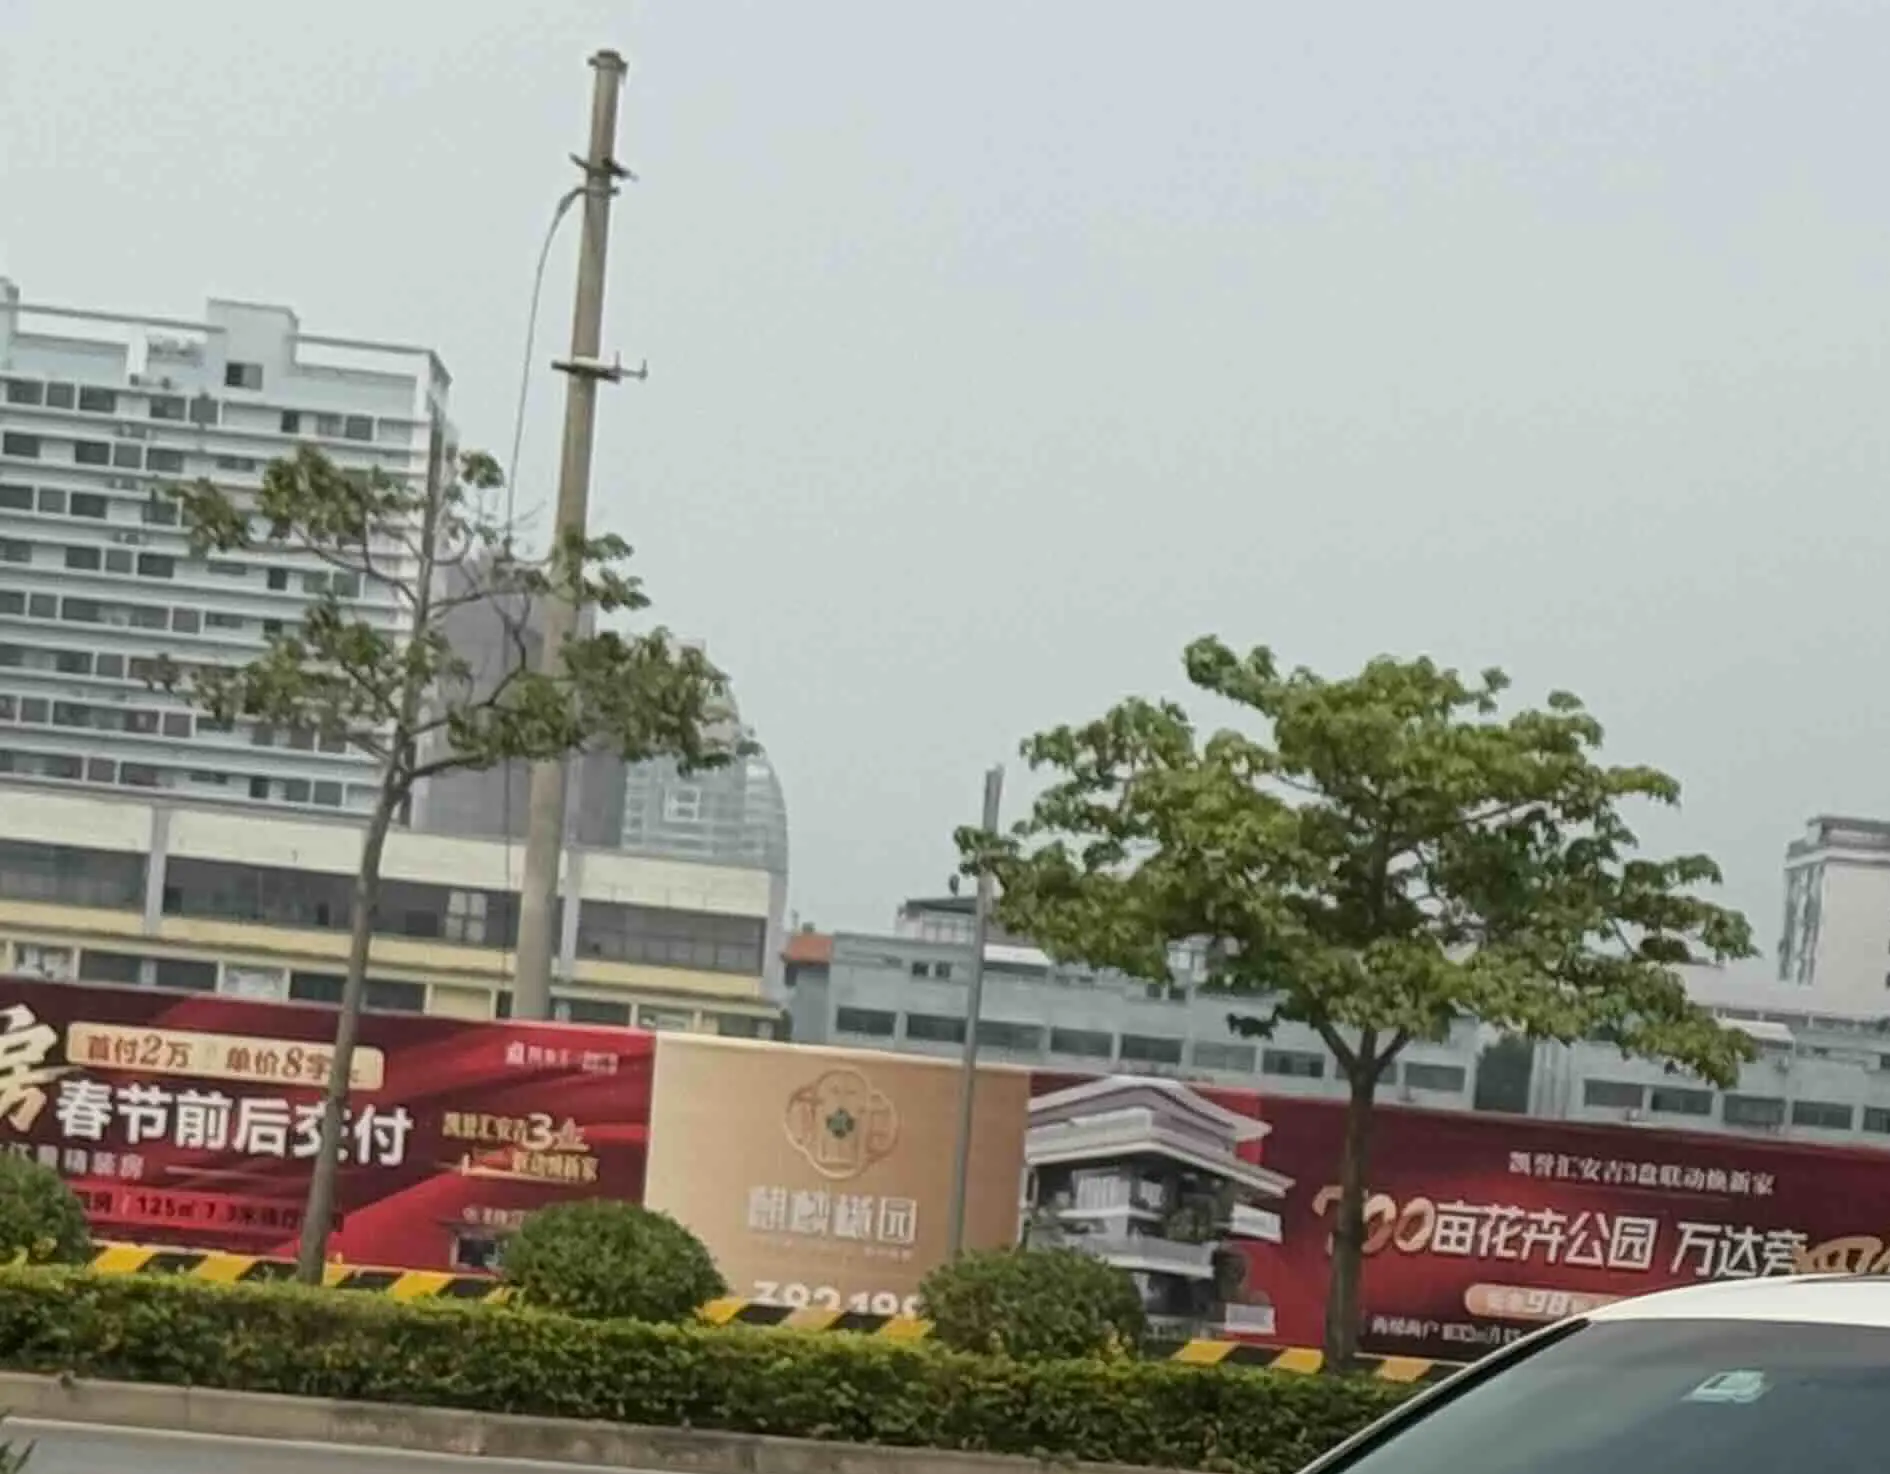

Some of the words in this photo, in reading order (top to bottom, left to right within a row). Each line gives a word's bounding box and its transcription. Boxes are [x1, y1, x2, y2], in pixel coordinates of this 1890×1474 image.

[226, 1047, 360, 1083] 单价8字
[56, 1080, 414, 1167] 春节前后交付
